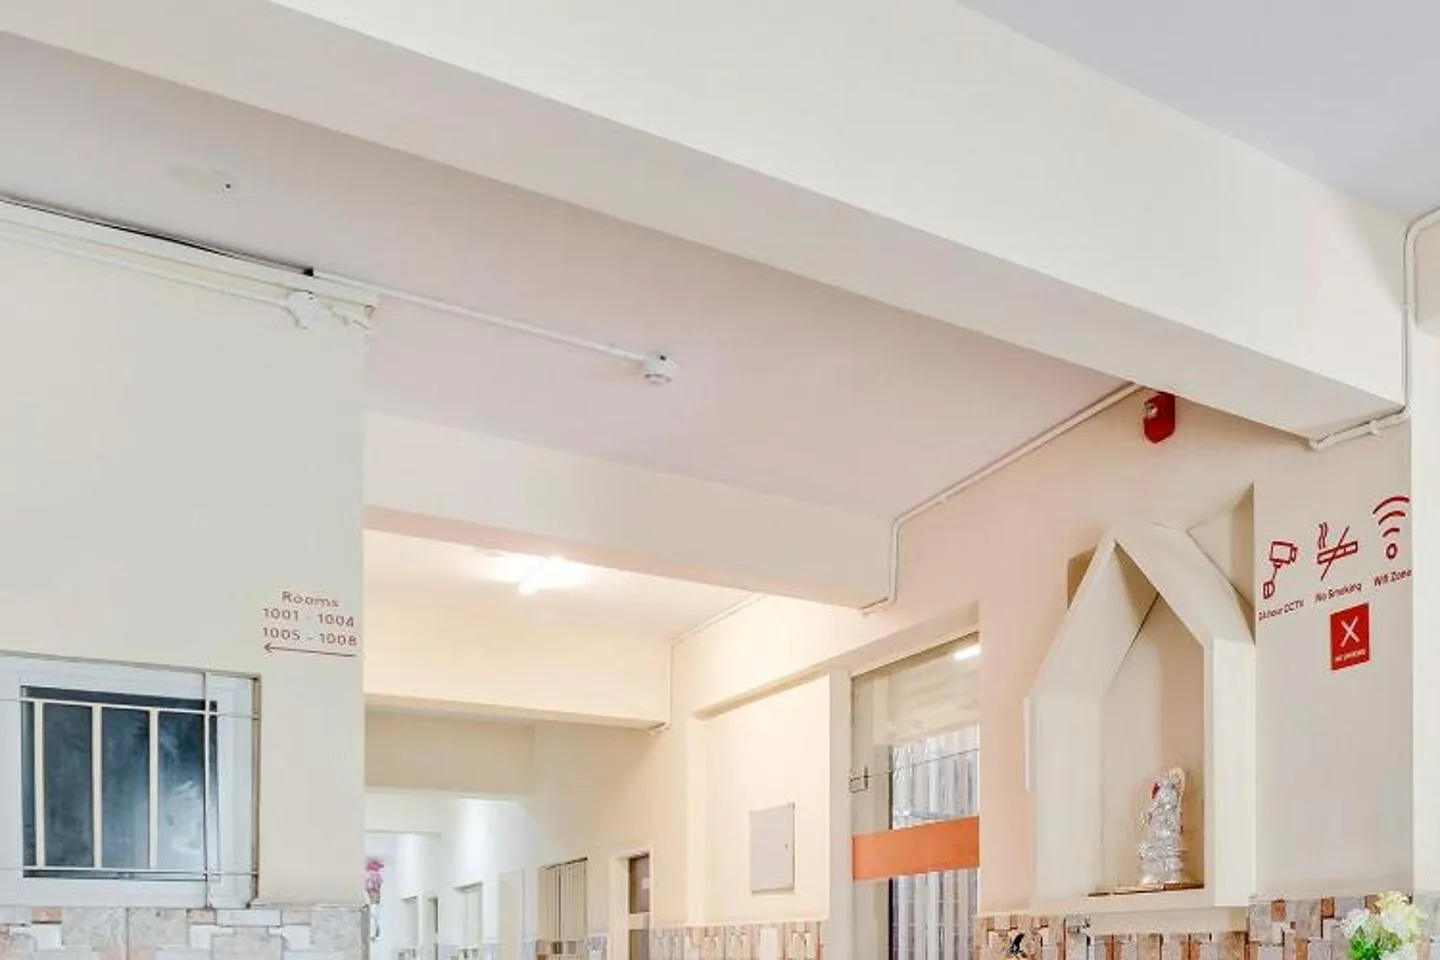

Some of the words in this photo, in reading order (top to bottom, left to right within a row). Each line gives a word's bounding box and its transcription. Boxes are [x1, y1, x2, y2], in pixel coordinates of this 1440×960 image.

[1390, 569, 1412, 583] Zone
[281, 590, 339, 608] Rooms
[1315, 592, 1327, 603] No
[1328, 582, 1362, 599] Smoking
[262, 607, 299, 622] 1001
[317, 613, 355, 628] 1004
[262, 626, 301, 641] 1005
[319, 632, 357, 647] 1008
